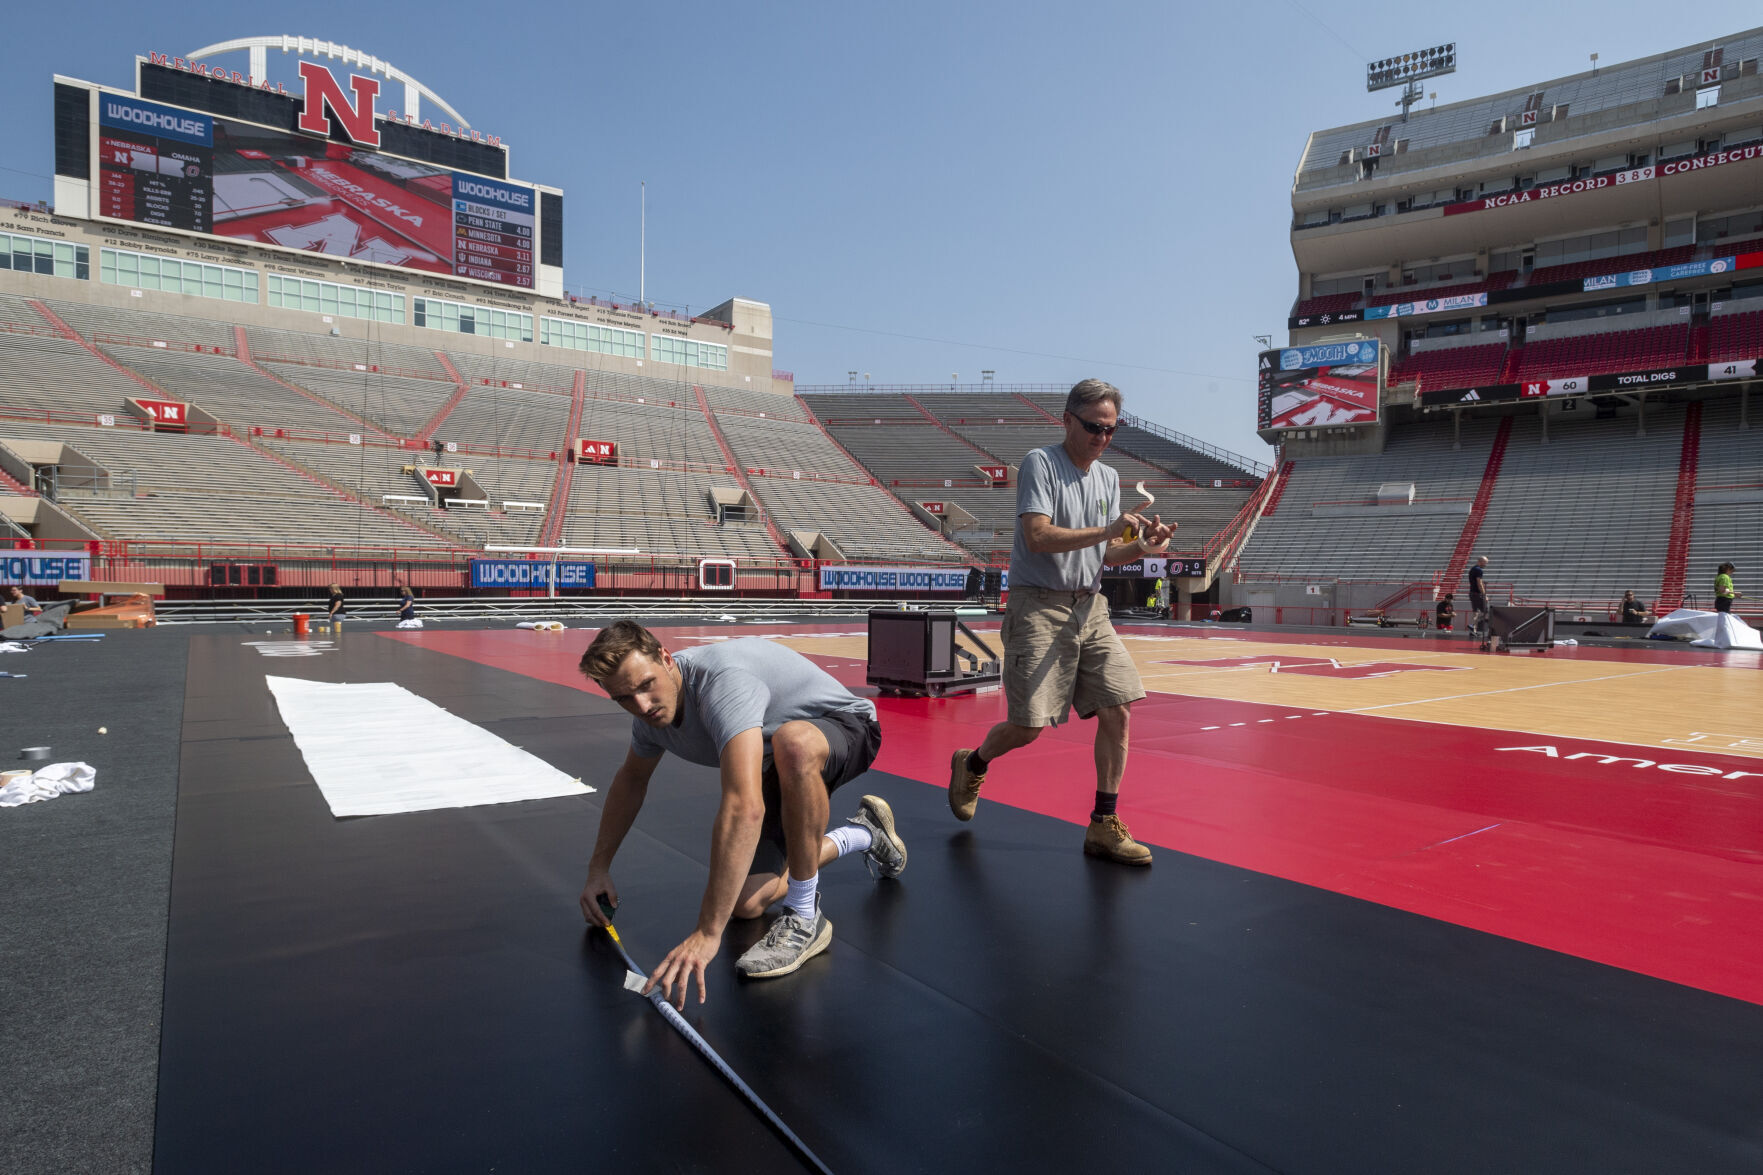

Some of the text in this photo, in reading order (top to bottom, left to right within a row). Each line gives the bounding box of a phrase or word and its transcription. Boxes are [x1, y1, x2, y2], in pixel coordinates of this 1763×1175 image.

[1703, 69, 1718, 82] N
[149, 51, 501, 147] MEMORIAL N STADIUM
[107, 103, 205, 137] WOODHOUSE
[1523, 111, 1537, 124] N
[110, 140, 152, 154] NEBRASKA
[114, 151, 128, 164] N
[172, 152, 201, 163] OMAHA
[310, 168, 423, 228] NEBRASKA
[458, 180, 529, 207] WOODHOUSE
[1485, 191, 1531, 209] NCAA
[1539, 176, 1608, 198] RECORD
[468, 204, 491, 216] BLOCKS
[496, 211, 507, 220] SET
[16, 224, 35, 232] Sam
[36, 228, 65, 237] Francis
[468, 216, 530, 236] PENN STATE 4.00
[468, 230, 502, 243] MINNESOTA
[120, 240, 144, 250] Bobby
[145, 244, 178, 254] Reynolds
[468, 242, 499, 255] NEBRASKA
[201, 253, 220, 262] Larry
[468, 255, 492, 266] INDIANA
[468, 268, 502, 281] WISCONSIN
[1584, 274, 1616, 287] MILAN
[1444, 296, 1474, 305] MILAN
[1724, 366, 1737, 376] 41
[1618, 371, 1676, 385] TOTAL DIGS
[1528, 384, 1541, 395] N
[1563, 382, 1577, 390] 60
[1566, 400, 1573, 408] 2
[164, 406, 179, 419] N
[600, 444, 611, 456] N
[442, 472, 452, 482] N
[994, 469, 1004, 478] N
[480, 564, 587, 583] WOODHOUSE
[1150, 564, 1158, 572] 0
[825, 572, 896, 586] WOODHOUSE
[899, 573, 964, 587] WOODHOUSE
